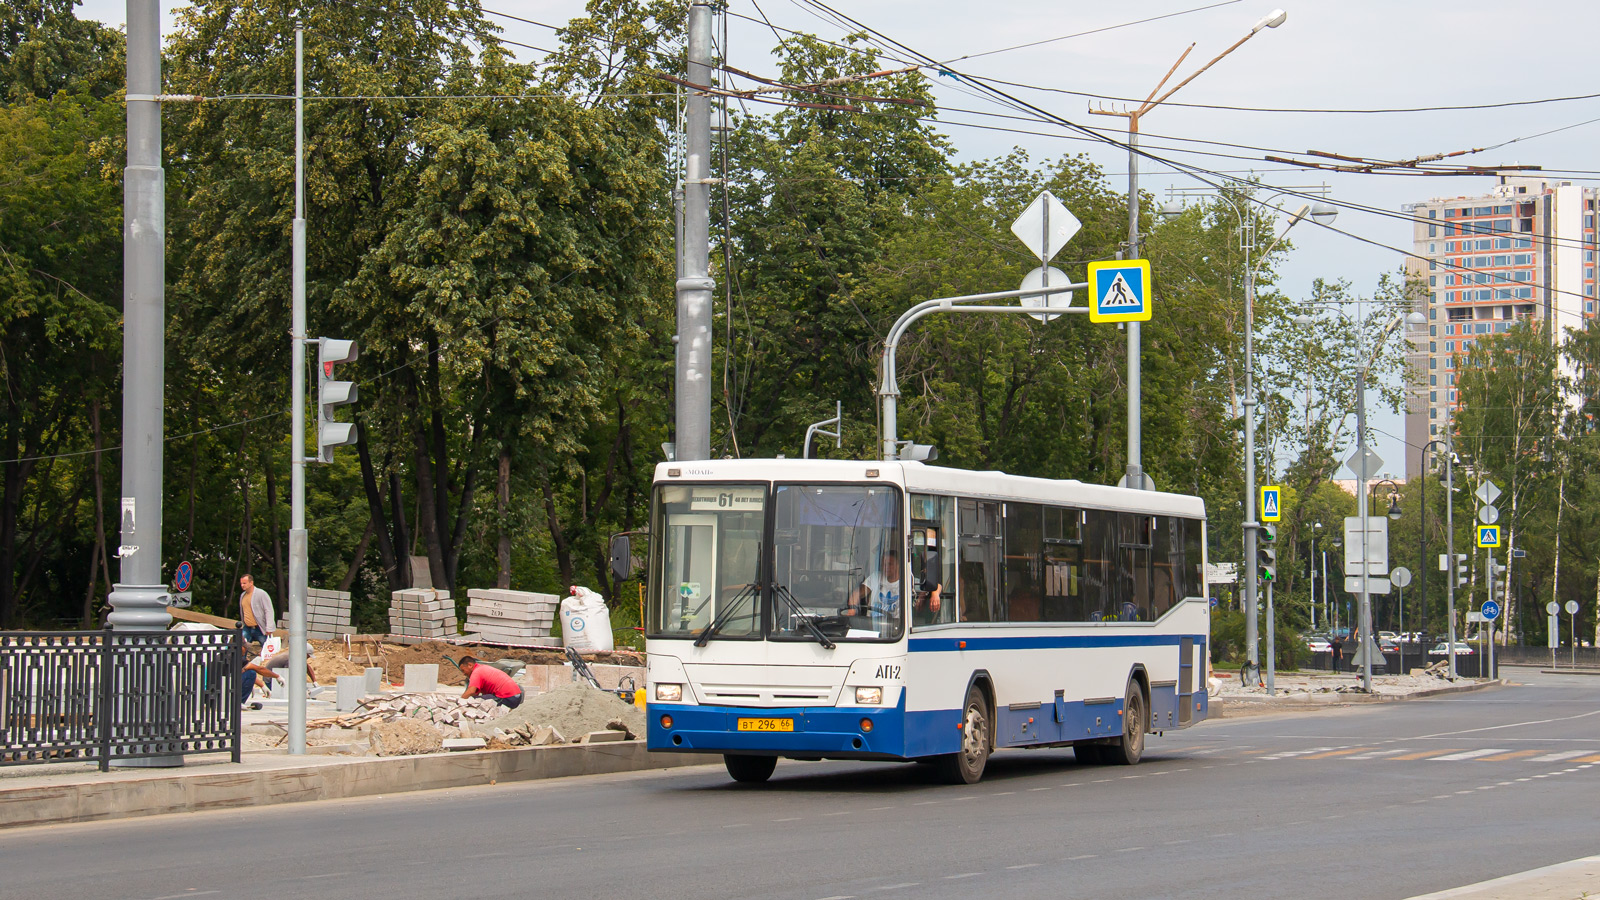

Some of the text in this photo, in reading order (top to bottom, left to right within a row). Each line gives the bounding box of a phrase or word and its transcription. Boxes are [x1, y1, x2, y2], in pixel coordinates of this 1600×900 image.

[719, 493, 734, 507] 61
[875, 664, 901, 680] АП-2
[743, 719, 790, 729] ВТ 296 66
